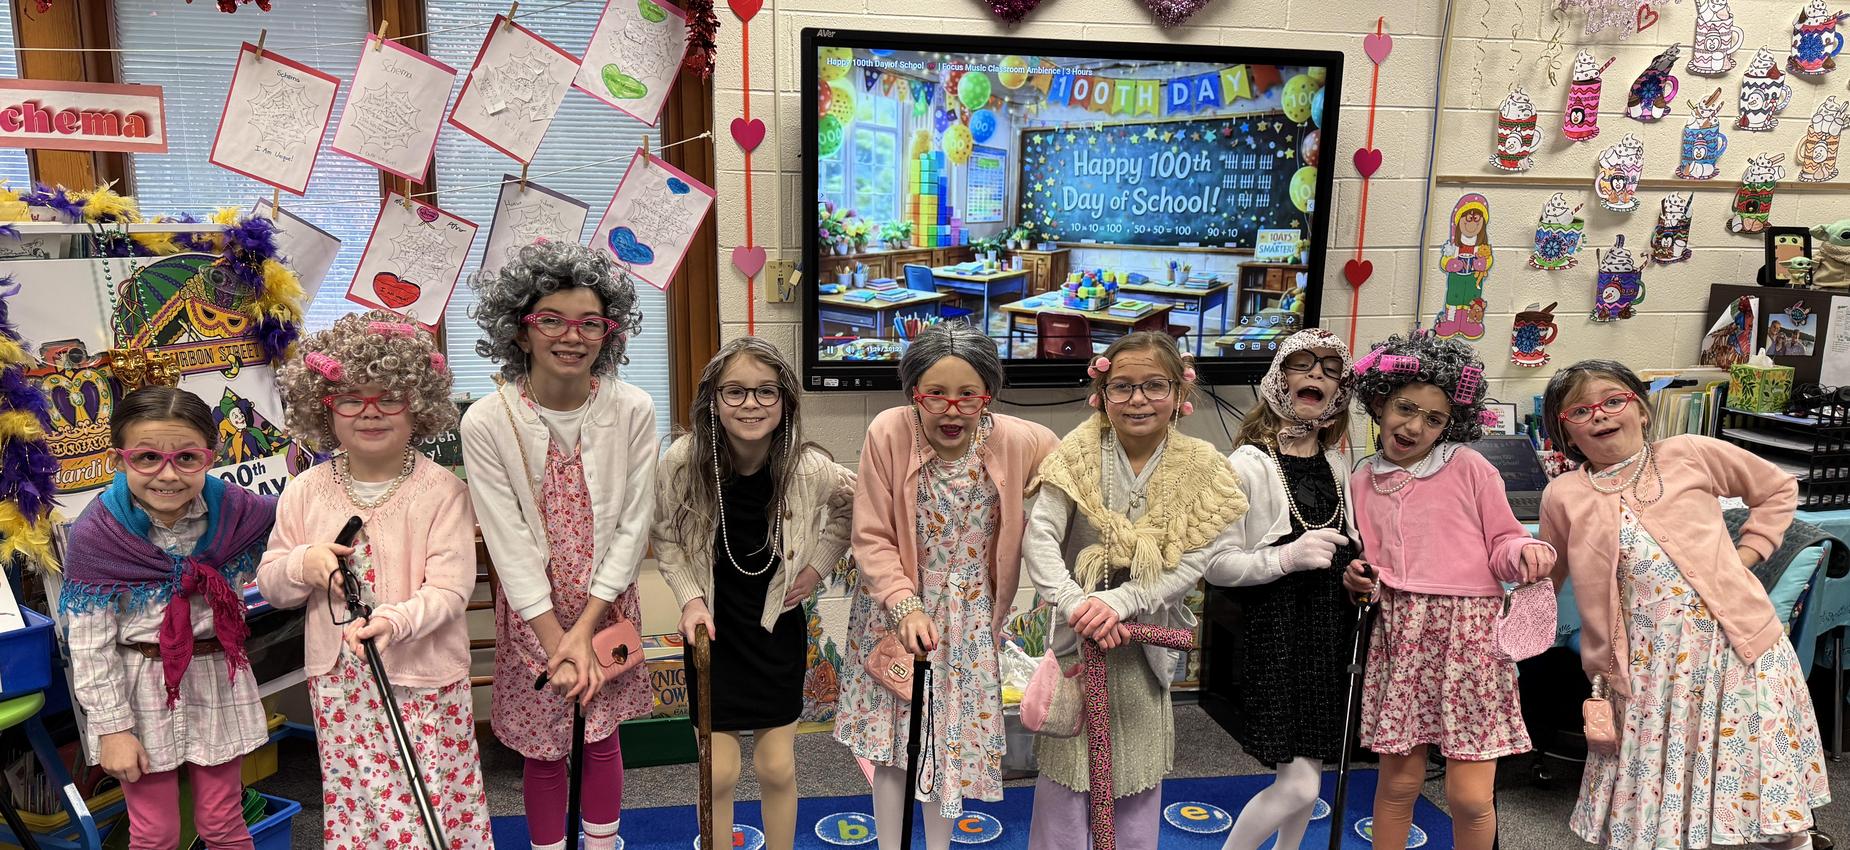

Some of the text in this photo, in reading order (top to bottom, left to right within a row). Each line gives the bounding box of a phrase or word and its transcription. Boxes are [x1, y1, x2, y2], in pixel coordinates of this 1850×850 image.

[817, 29, 836, 38] AVer
[276, 69, 300, 83] Schema
[826, 57, 850, 68] Happy
[852, 59, 874, 67] 100th
[874, 60, 889, 69] Day
[899, 61, 924, 69] School
[942, 63, 964, 71] Focus
[964, 64, 987, 72] Music
[987, 65, 1025, 74] Classroom
[1026, 66, 1061, 75] Ambience
[1072, 68, 1093, 76] Hours
[1058, 70, 1242, 107] 100TH DAY
[0, 102, 146, 138] chema
[1073, 150, 1212, 185] Happy 100th
[1062, 186, 1221, 219] Day of School!
[1071, 223, 1081, 232] 10
[1088, 223, 1099, 233] 10
[1106, 223, 1123, 233] 100
[1134, 225, 1146, 234] 50
[1153, 225, 1165, 235] 50
[1174, 225, 1192, 236] 100
[1207, 227, 1220, 238] 90
[1228, 228, 1239, 238] 10
[650, 669, 686, 692] KNIG
[661, 687, 686, 705] OW
[838, 820, 869, 840] b
[958, 819, 983, 833] c
